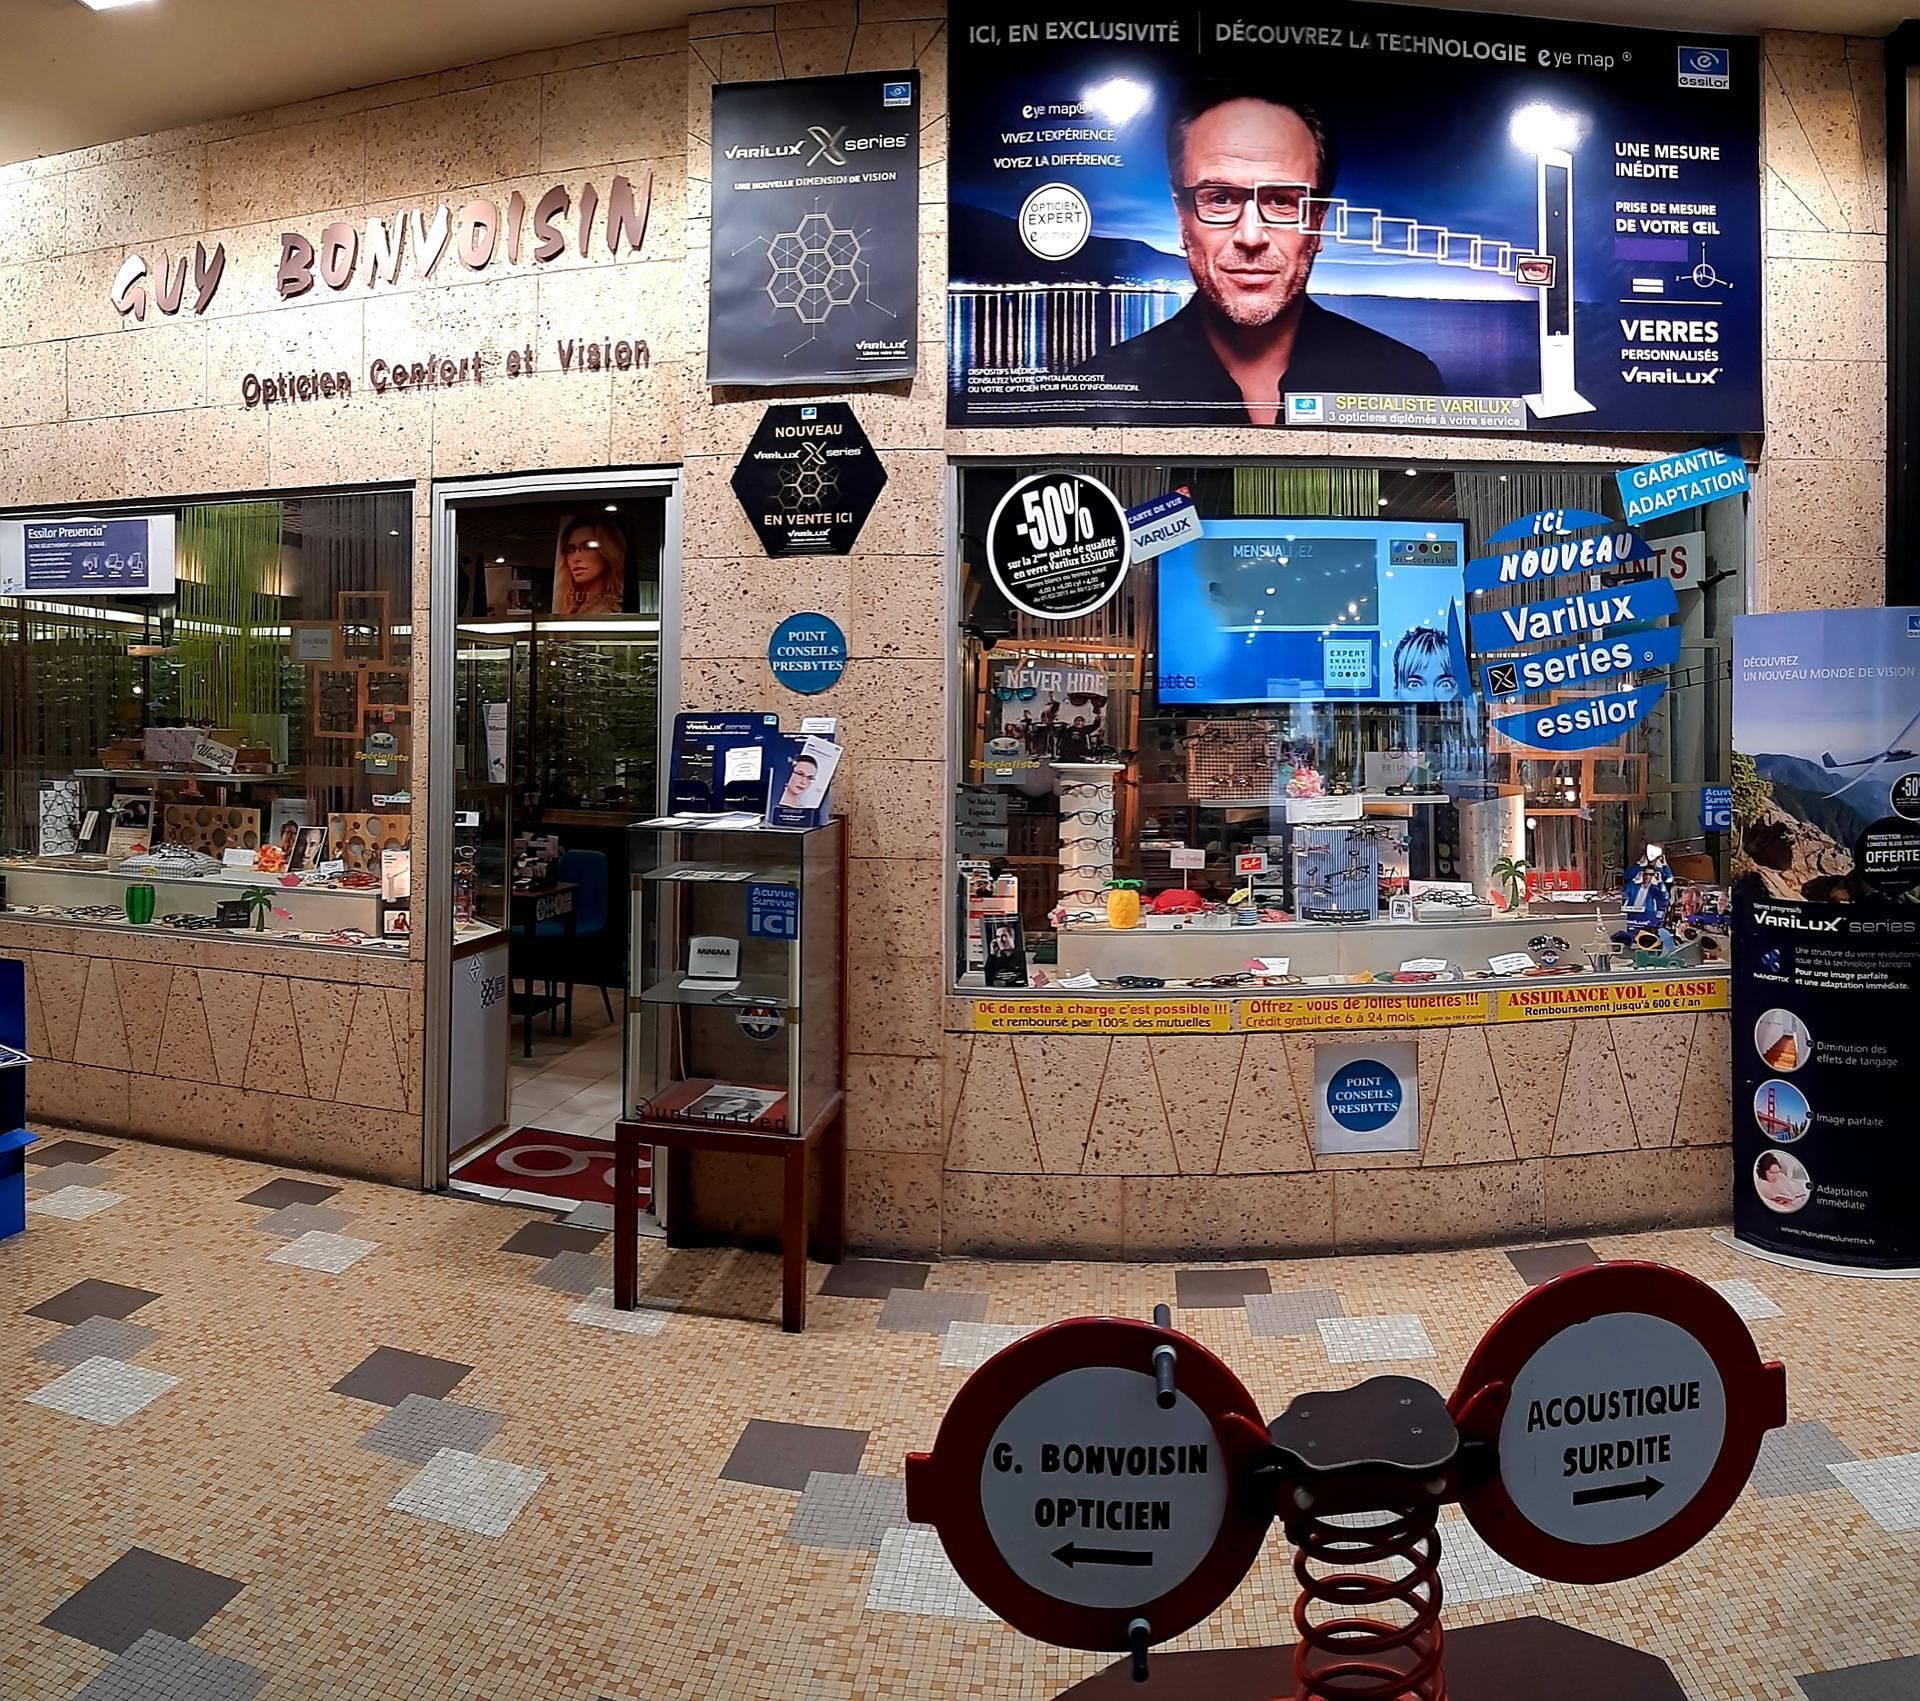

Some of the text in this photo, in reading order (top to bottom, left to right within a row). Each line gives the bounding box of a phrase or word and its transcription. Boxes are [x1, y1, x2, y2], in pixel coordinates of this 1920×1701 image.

[969, 20, 1180, 46] ICI, EN EXCLUSIVITÉ
[1216, 19, 1343, 47] DÉCOUVREZ
[1349, 30, 1373, 49] LA
[1376, 32, 1527, 62] TECHNOLOGIE
[1578, 51, 1614, 71] map
[1679, 76, 1729, 88] essilor
[1001, 127, 1117, 144] VIVEZ L'EXPÉRIENCE,
[724, 140, 806, 160] VARILUX
[1615, 142, 1720, 161] UNE MESURE
[993, 155, 1049, 169] VOYEZ LA
[1615, 160, 1679, 179] INÉDITE
[752, 172, 897, 189] NOUVELLE DIMENSION VISION
[1030, 202, 1078, 212] OPTICIEN
[1615, 201, 1717, 215] PRISE DE MESURE
[1028, 211, 1082, 225] EXPERT
[1616, 219, 1720, 235] DE VOTRE ŒIL
[110, 168, 654, 322] GUY BONVOISIN
[1620, 319, 1719, 343] VERRES
[1621, 348, 1719, 362] PERSONNALISÉS
[241, 336, 651, 411] Opticien Confort et Vision
[967, 368, 1009, 376] DISPOSITIFS
[967, 374, 1105, 385] CONSULTEZ VOTRE OPHTALMOLOGISTE
[980, 385, 1004, 393] VOTRE
[1005, 384, 1040, 393] OPTICIEN
[1060, 383, 1078, 391] PLUS
[1336, 395, 1437, 413] SPECIALISTE
[1339, 411, 1521, 427] opticiens diplômés votre service
[775, 424, 843, 437] NOUVEAU
[1632, 451, 1727, 490] GARANTIE
[1627, 468, 1746, 518] ADAPTATION
[764, 512, 852, 526] EN VENTE ICI
[1127, 497, 1183, 525] CARTE DE VUE
[28, 527, 57, 539] Essilor
[1133, 516, 1191, 548] VARILUX
[1007, 537, 1117, 571] sur paire qualité
[1499, 532, 1633, 583] NOUVEAU
[1026, 557, 1080, 578] verre Varilux
[1502, 594, 1635, 643] Varilux
[788, 631, 827, 642] POINT
[777, 645, 838, 657] CONSEILS
[772, 660, 843, 672] PRESBYTES
[1522, 642, 1633, 689] series
[1743, 655, 1799, 668] DÉCOUVREZ
[1006, 669, 1106, 695] NEVER HIDE
[1743, 666, 1915, 682] UN NOUVEAU MONDE DE VISION
[1536, 697, 1638, 739] essilor
[1866, 849, 1920, 863] OFFERTE
[752, 887, 795, 899] Acuvue
[752, 897, 795, 909] Surevue
[1753, 910, 1916, 933] VARILUX series
[697, 947, 731, 956] MINIMA
[1795, 947, 1809, 955] Une
[1810, 948, 1844, 958] structure
[1833, 958, 1877, 969] technologie
[1795, 967, 1889, 981] Pour une image parfaite
[1804, 979, 1909, 991] une adaptation immédiate.
[1508, 981, 1716, 1006] ASSURANCE VOL CASSE
[999, 1003, 1210, 1017] de reste charge c'est possible
[1250, 994, 1461, 1014] Offrez vous de lunettes
[1524, 998, 1671, 1017] Remboursement jusqu'à 600
[991, 1016, 1211, 1029] et remboursé par 100% des mutuelles
[1245, 1011, 1415, 1029] Crédit gratuit de 24 mois
[1817, 1041, 1888, 1055] Diminution des
[1816, 1053, 1898, 1069] effets tangage
[1346, 1077, 1382, 1088] POINT
[1335, 1089, 1394, 1101] CONSEILS
[1331, 1102, 1398, 1114] PRESBYTES
[1816, 1113, 1884, 1132] Image parfaite
[1817, 1184, 1869, 1200] Adaptation
[1816, 1197, 1866, 1210] immédiate
[1525, 1380, 1702, 1433] ACOUSTIQUE
[992, 1441, 1209, 1479] G. BONVOISIN
[1562, 1434, 1671, 1477] SURDITE
[1033, 1499, 1171, 1532] OPTICIEN
